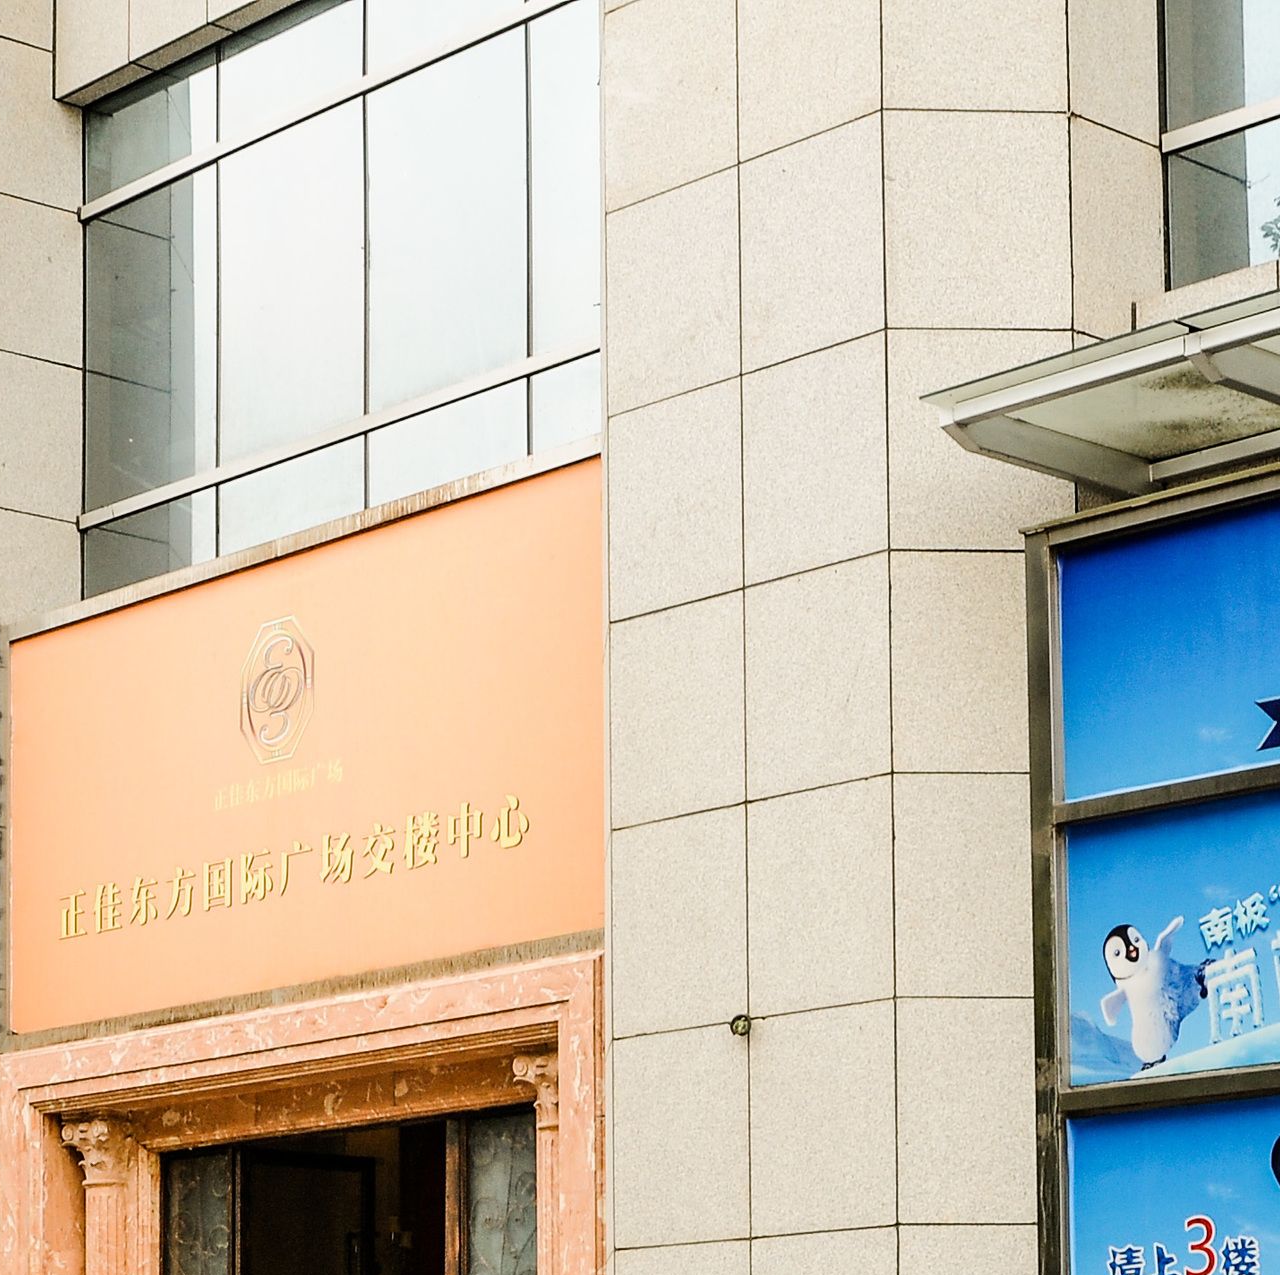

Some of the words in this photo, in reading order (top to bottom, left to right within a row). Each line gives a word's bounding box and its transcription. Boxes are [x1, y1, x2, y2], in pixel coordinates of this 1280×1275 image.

[57, 794, 530, 940] 正佳东方国际广场交楼中心
